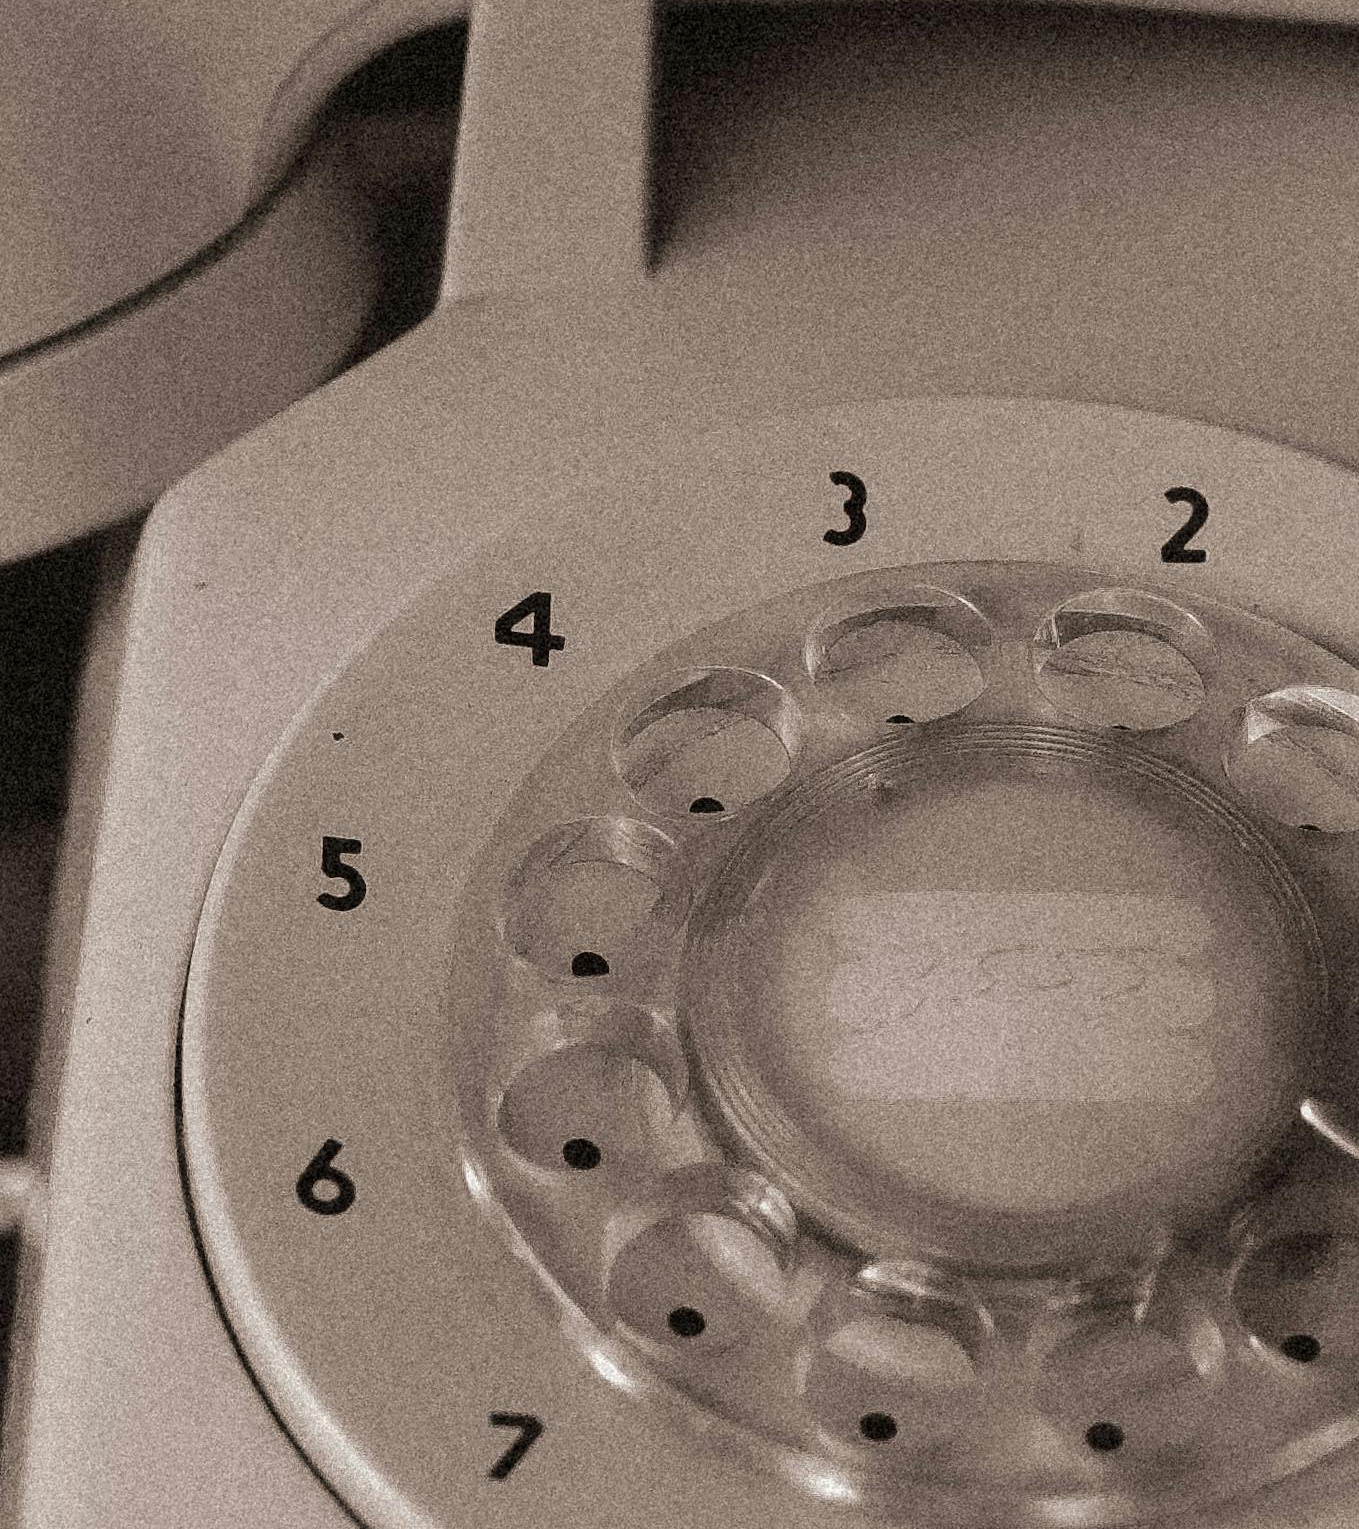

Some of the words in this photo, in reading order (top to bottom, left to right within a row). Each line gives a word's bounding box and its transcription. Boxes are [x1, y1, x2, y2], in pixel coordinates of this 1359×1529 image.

[826, 472, 866, 545] 3
[1162, 488, 1208, 563] 2
[495, 593, 563, 666] 4
[319, 837, 365, 911] 5
[297, 1141, 354, 1215] 6
[491, 1413, 542, 1479] 7
